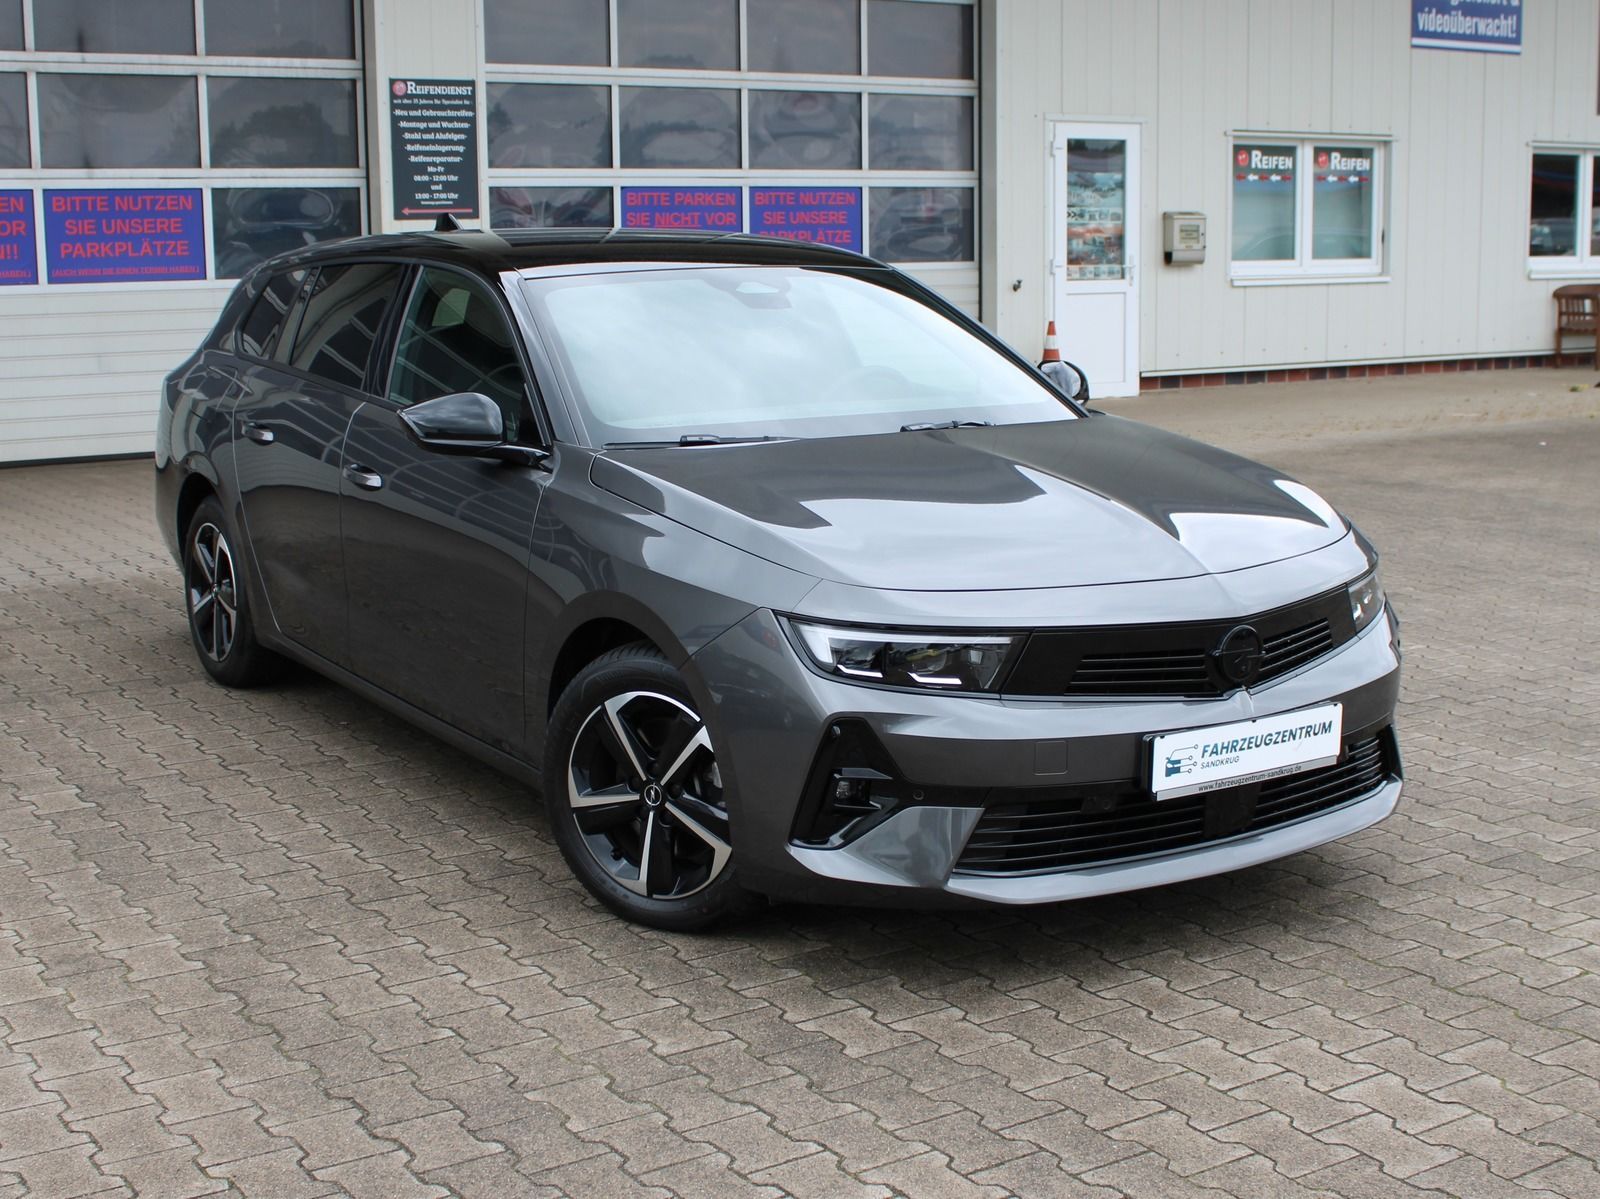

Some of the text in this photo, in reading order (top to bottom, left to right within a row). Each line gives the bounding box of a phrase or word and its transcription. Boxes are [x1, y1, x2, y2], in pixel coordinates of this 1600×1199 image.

[1417, 7, 1517, 38] videoüberwacht!
[409, 109, 421, 117] und
[52, 195, 193, 212] BITTE NUTZEN
[626, 192, 736, 206] BITTE PARKEN
[754, 192, 856, 206] BITTE NUTZEN
[65, 217, 183, 235] SIE UNSERE
[626, 212, 737, 227] SIE NICHT VOR
[763, 211, 848, 225] SIE UNSERE
[60, 238, 189, 259] PARKPLÄTZE
[1201, 720, 1333, 759] FAHRZEUGZENTRUM
[1200, 755, 1240, 770] SANDKRUG
[1198, 765, 1302, 792] www.fahrzeugzentrum-sandkrug.de
